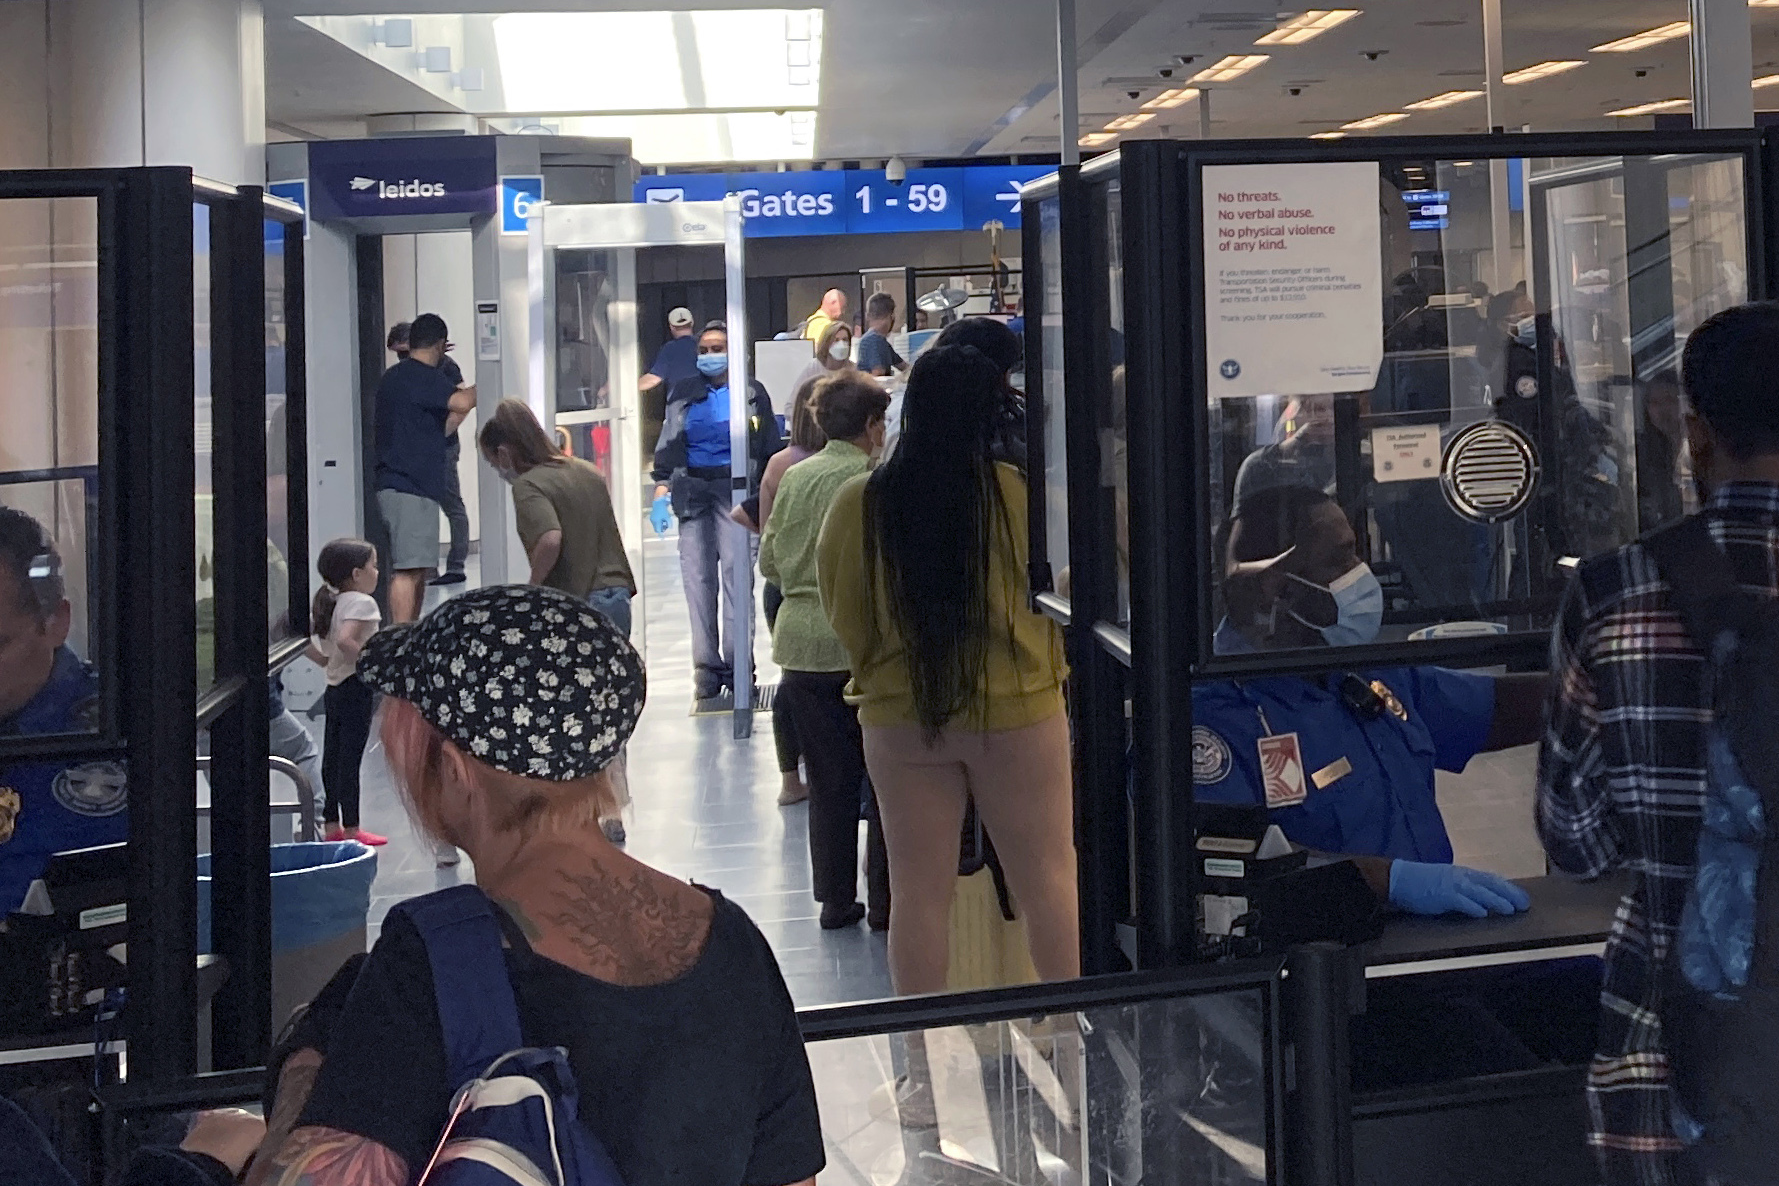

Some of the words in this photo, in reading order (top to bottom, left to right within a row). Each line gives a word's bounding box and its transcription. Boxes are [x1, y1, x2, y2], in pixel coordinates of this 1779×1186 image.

[379, 179, 446, 199] leidos
[1218, 192, 1234, 203] No
[1237, 191, 1281, 203] threats.
[514, 191, 530, 219] 6
[740, 188, 834, 218] Gates
[855, 185, 870, 214] 1
[885, 198, 898, 207] -
[908, 183, 947, 213] 59
[1218, 210, 1234, 220] No
[1238, 208, 1275, 219] verbal
[1277, 207, 1314, 219] abuse.
[1219, 227, 1235, 238] No
[1238, 224, 1285, 240] physical
[1288, 224, 1335, 235] violence
[1219, 241, 1231, 251] of
[1234, 242, 1256, 253] any
[1259, 239, 1287, 250] kind.
